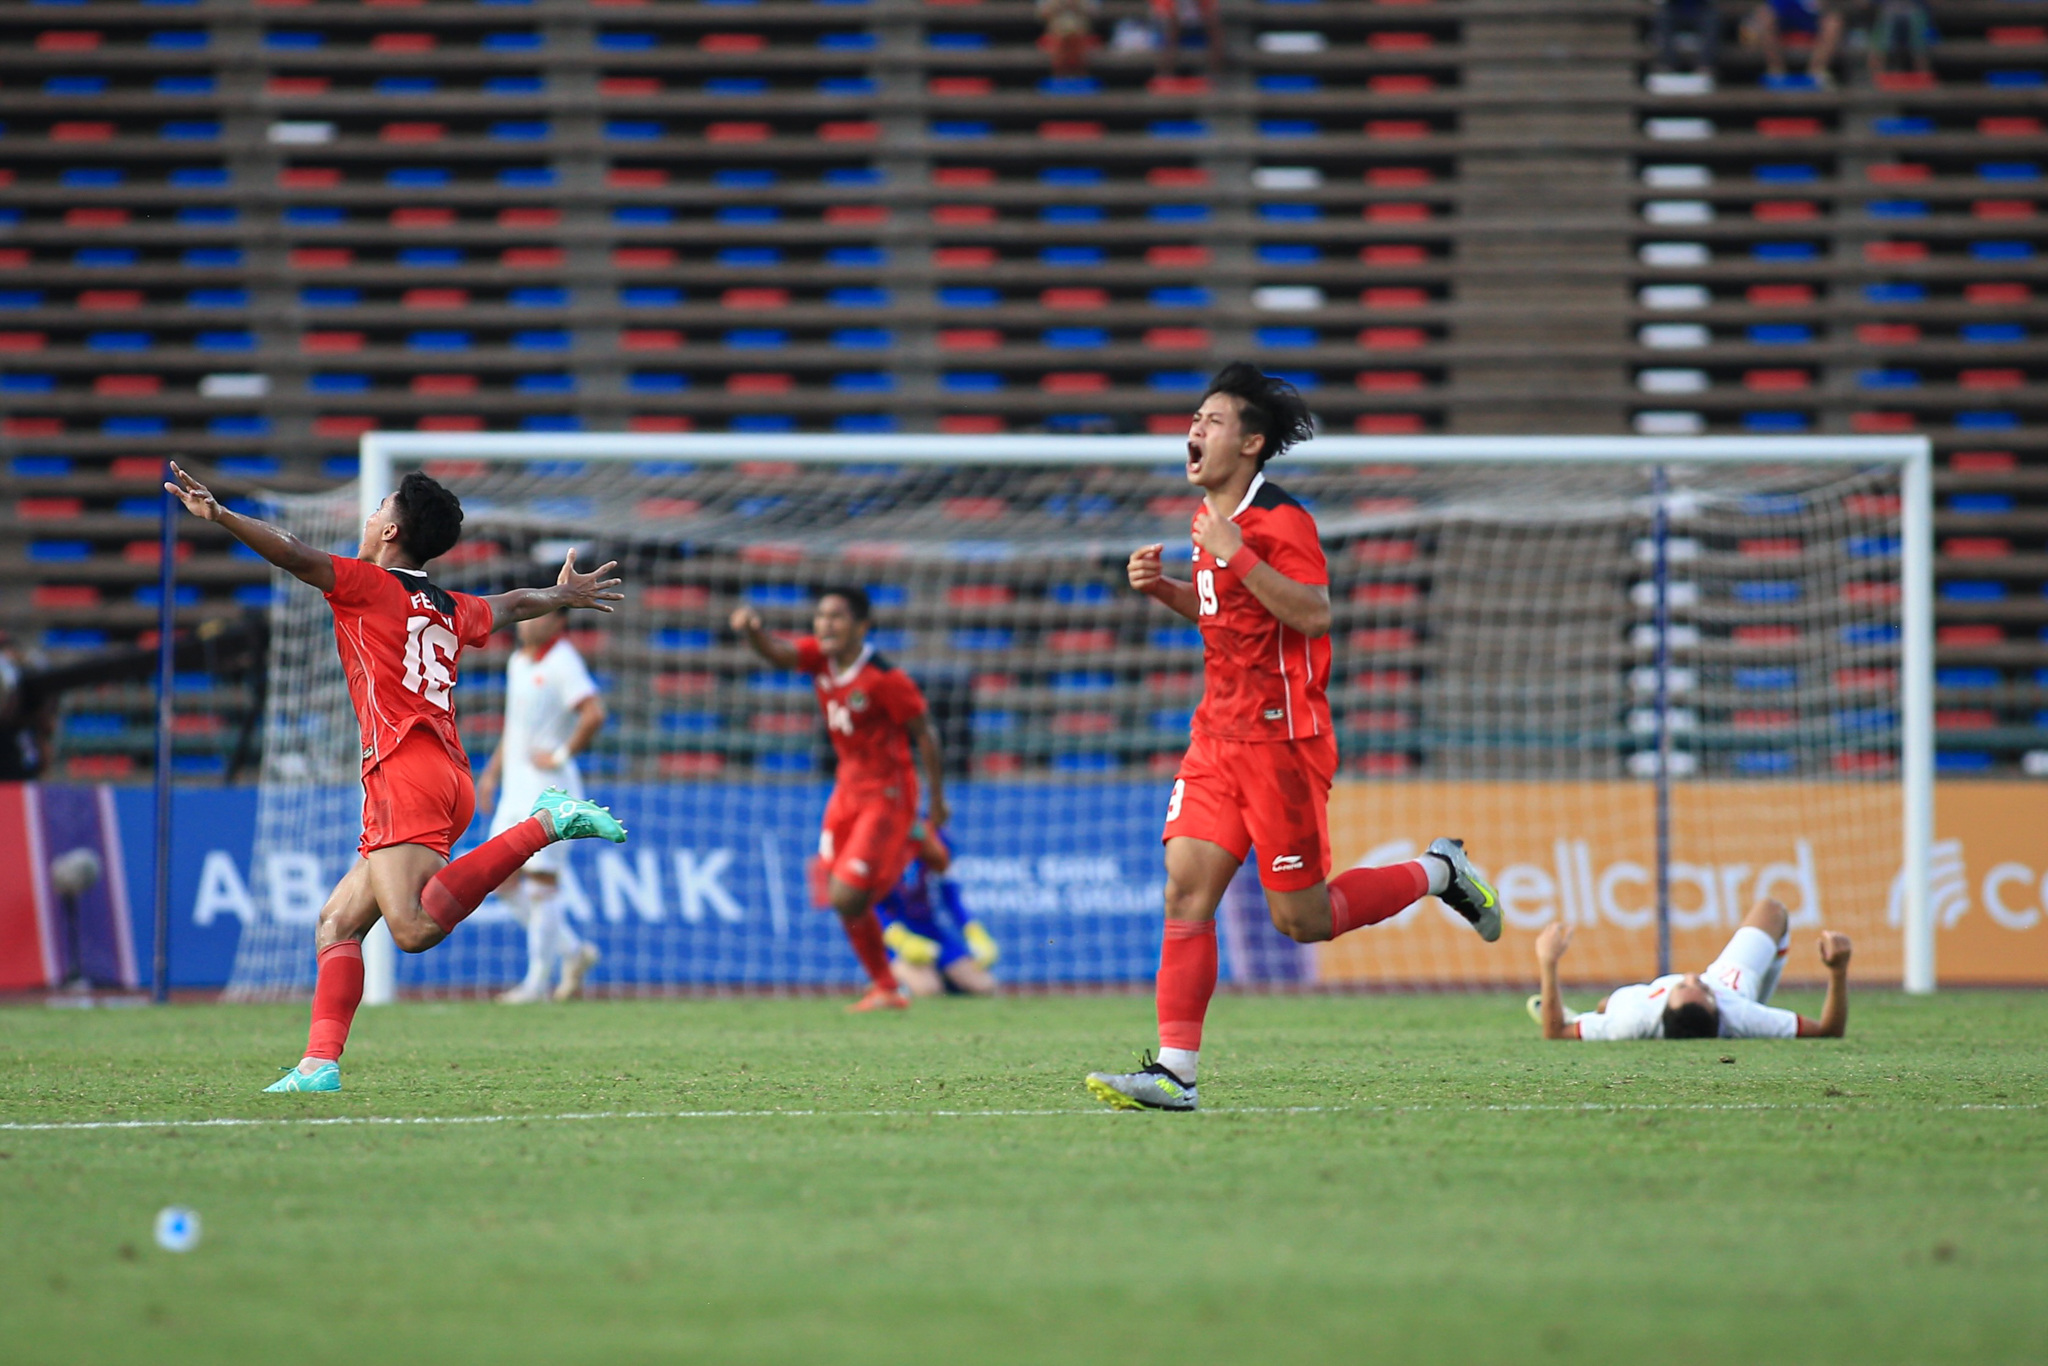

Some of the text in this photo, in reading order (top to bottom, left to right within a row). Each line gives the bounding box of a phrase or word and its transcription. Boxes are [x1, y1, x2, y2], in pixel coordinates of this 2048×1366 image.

[1196, 568, 1219, 617] 19
[401, 615, 459, 712] 16
[192, 850, 332, 925] AB
